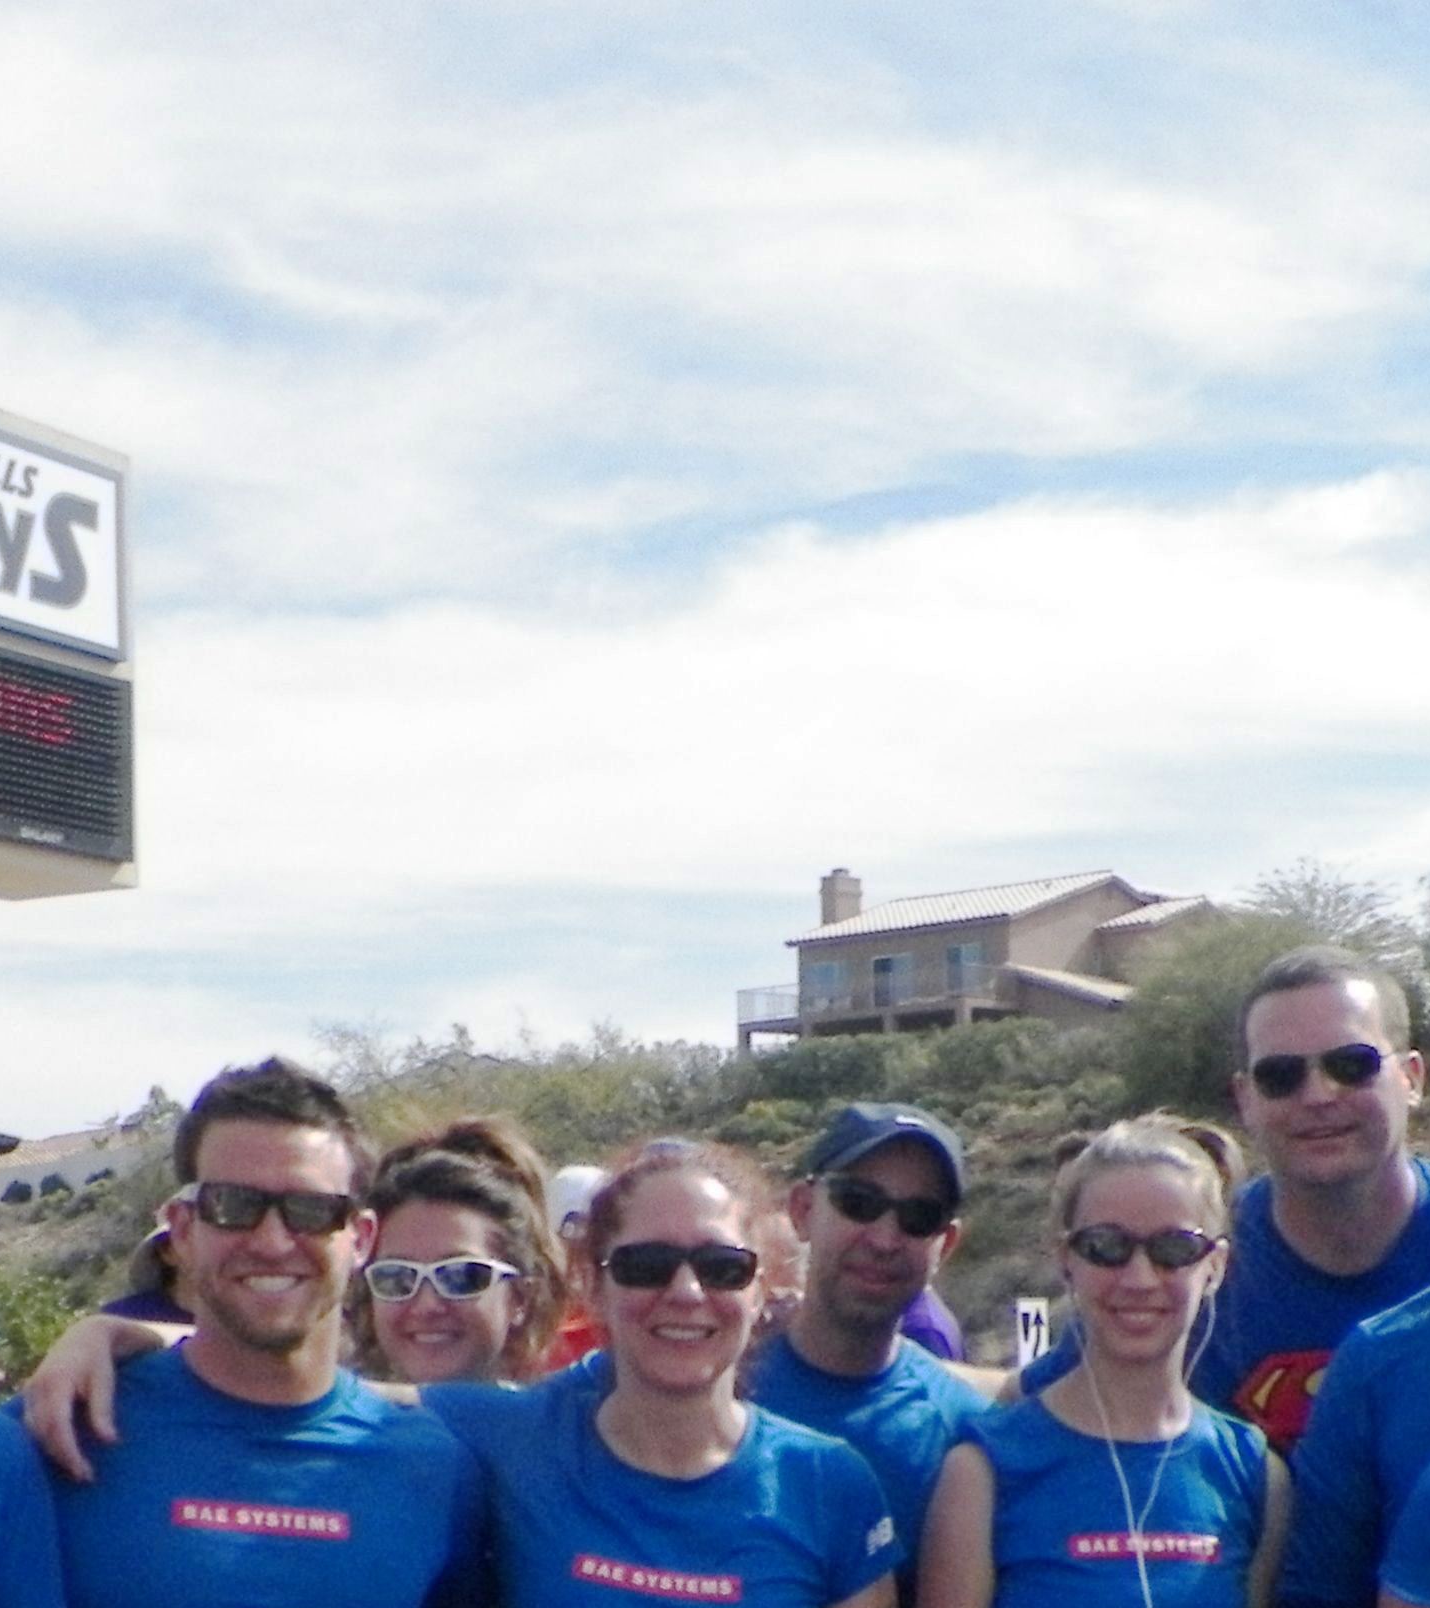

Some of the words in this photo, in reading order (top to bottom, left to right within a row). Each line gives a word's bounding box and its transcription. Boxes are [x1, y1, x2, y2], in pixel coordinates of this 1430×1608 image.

[182, 1504, 229, 1524] BAE
[234, 1508, 342, 1534] SYSTEMS
[1077, 1537, 1120, 1553] BAE
[581, 1559, 624, 1582] BAE
[630, 1570, 733, 1596] SYSTEMS
